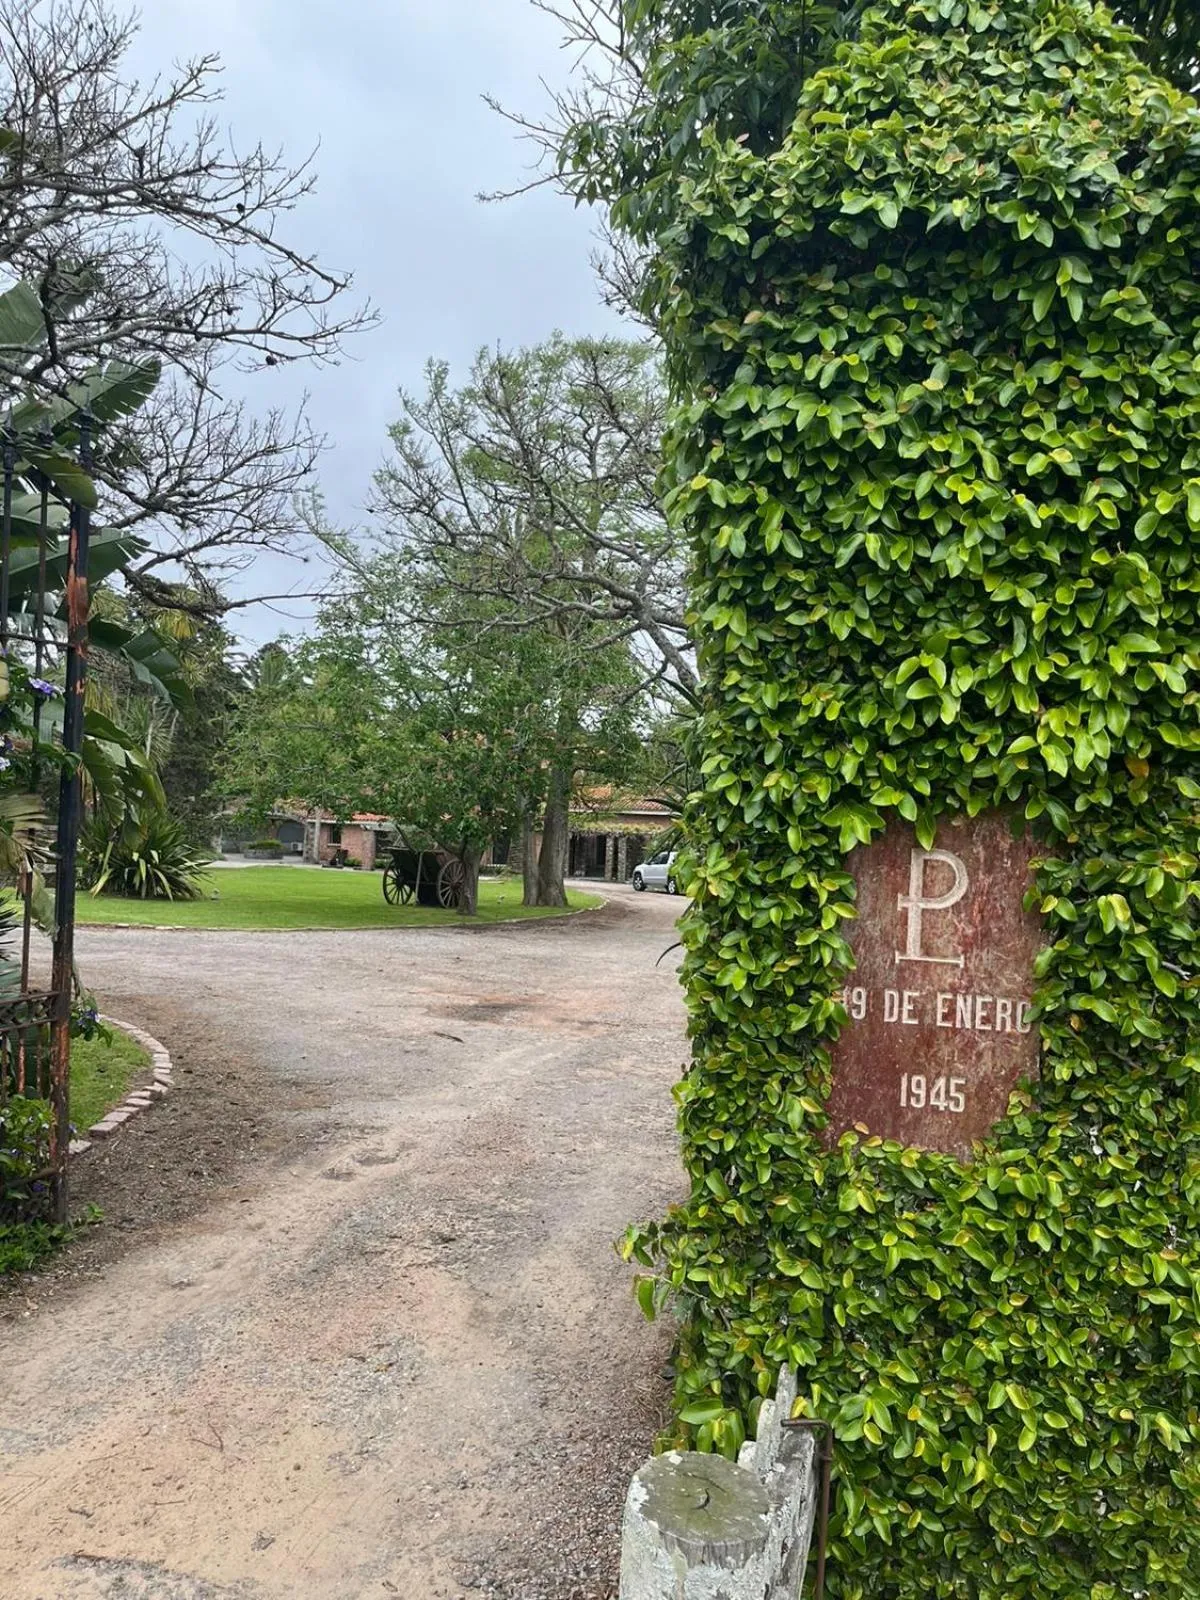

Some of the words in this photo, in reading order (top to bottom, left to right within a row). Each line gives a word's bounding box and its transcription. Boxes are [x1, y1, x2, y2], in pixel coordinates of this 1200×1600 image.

[883, 989, 920, 1025] DE
[936, 992, 1032, 1034] ENERO
[900, 1073, 966, 1113] 1945
